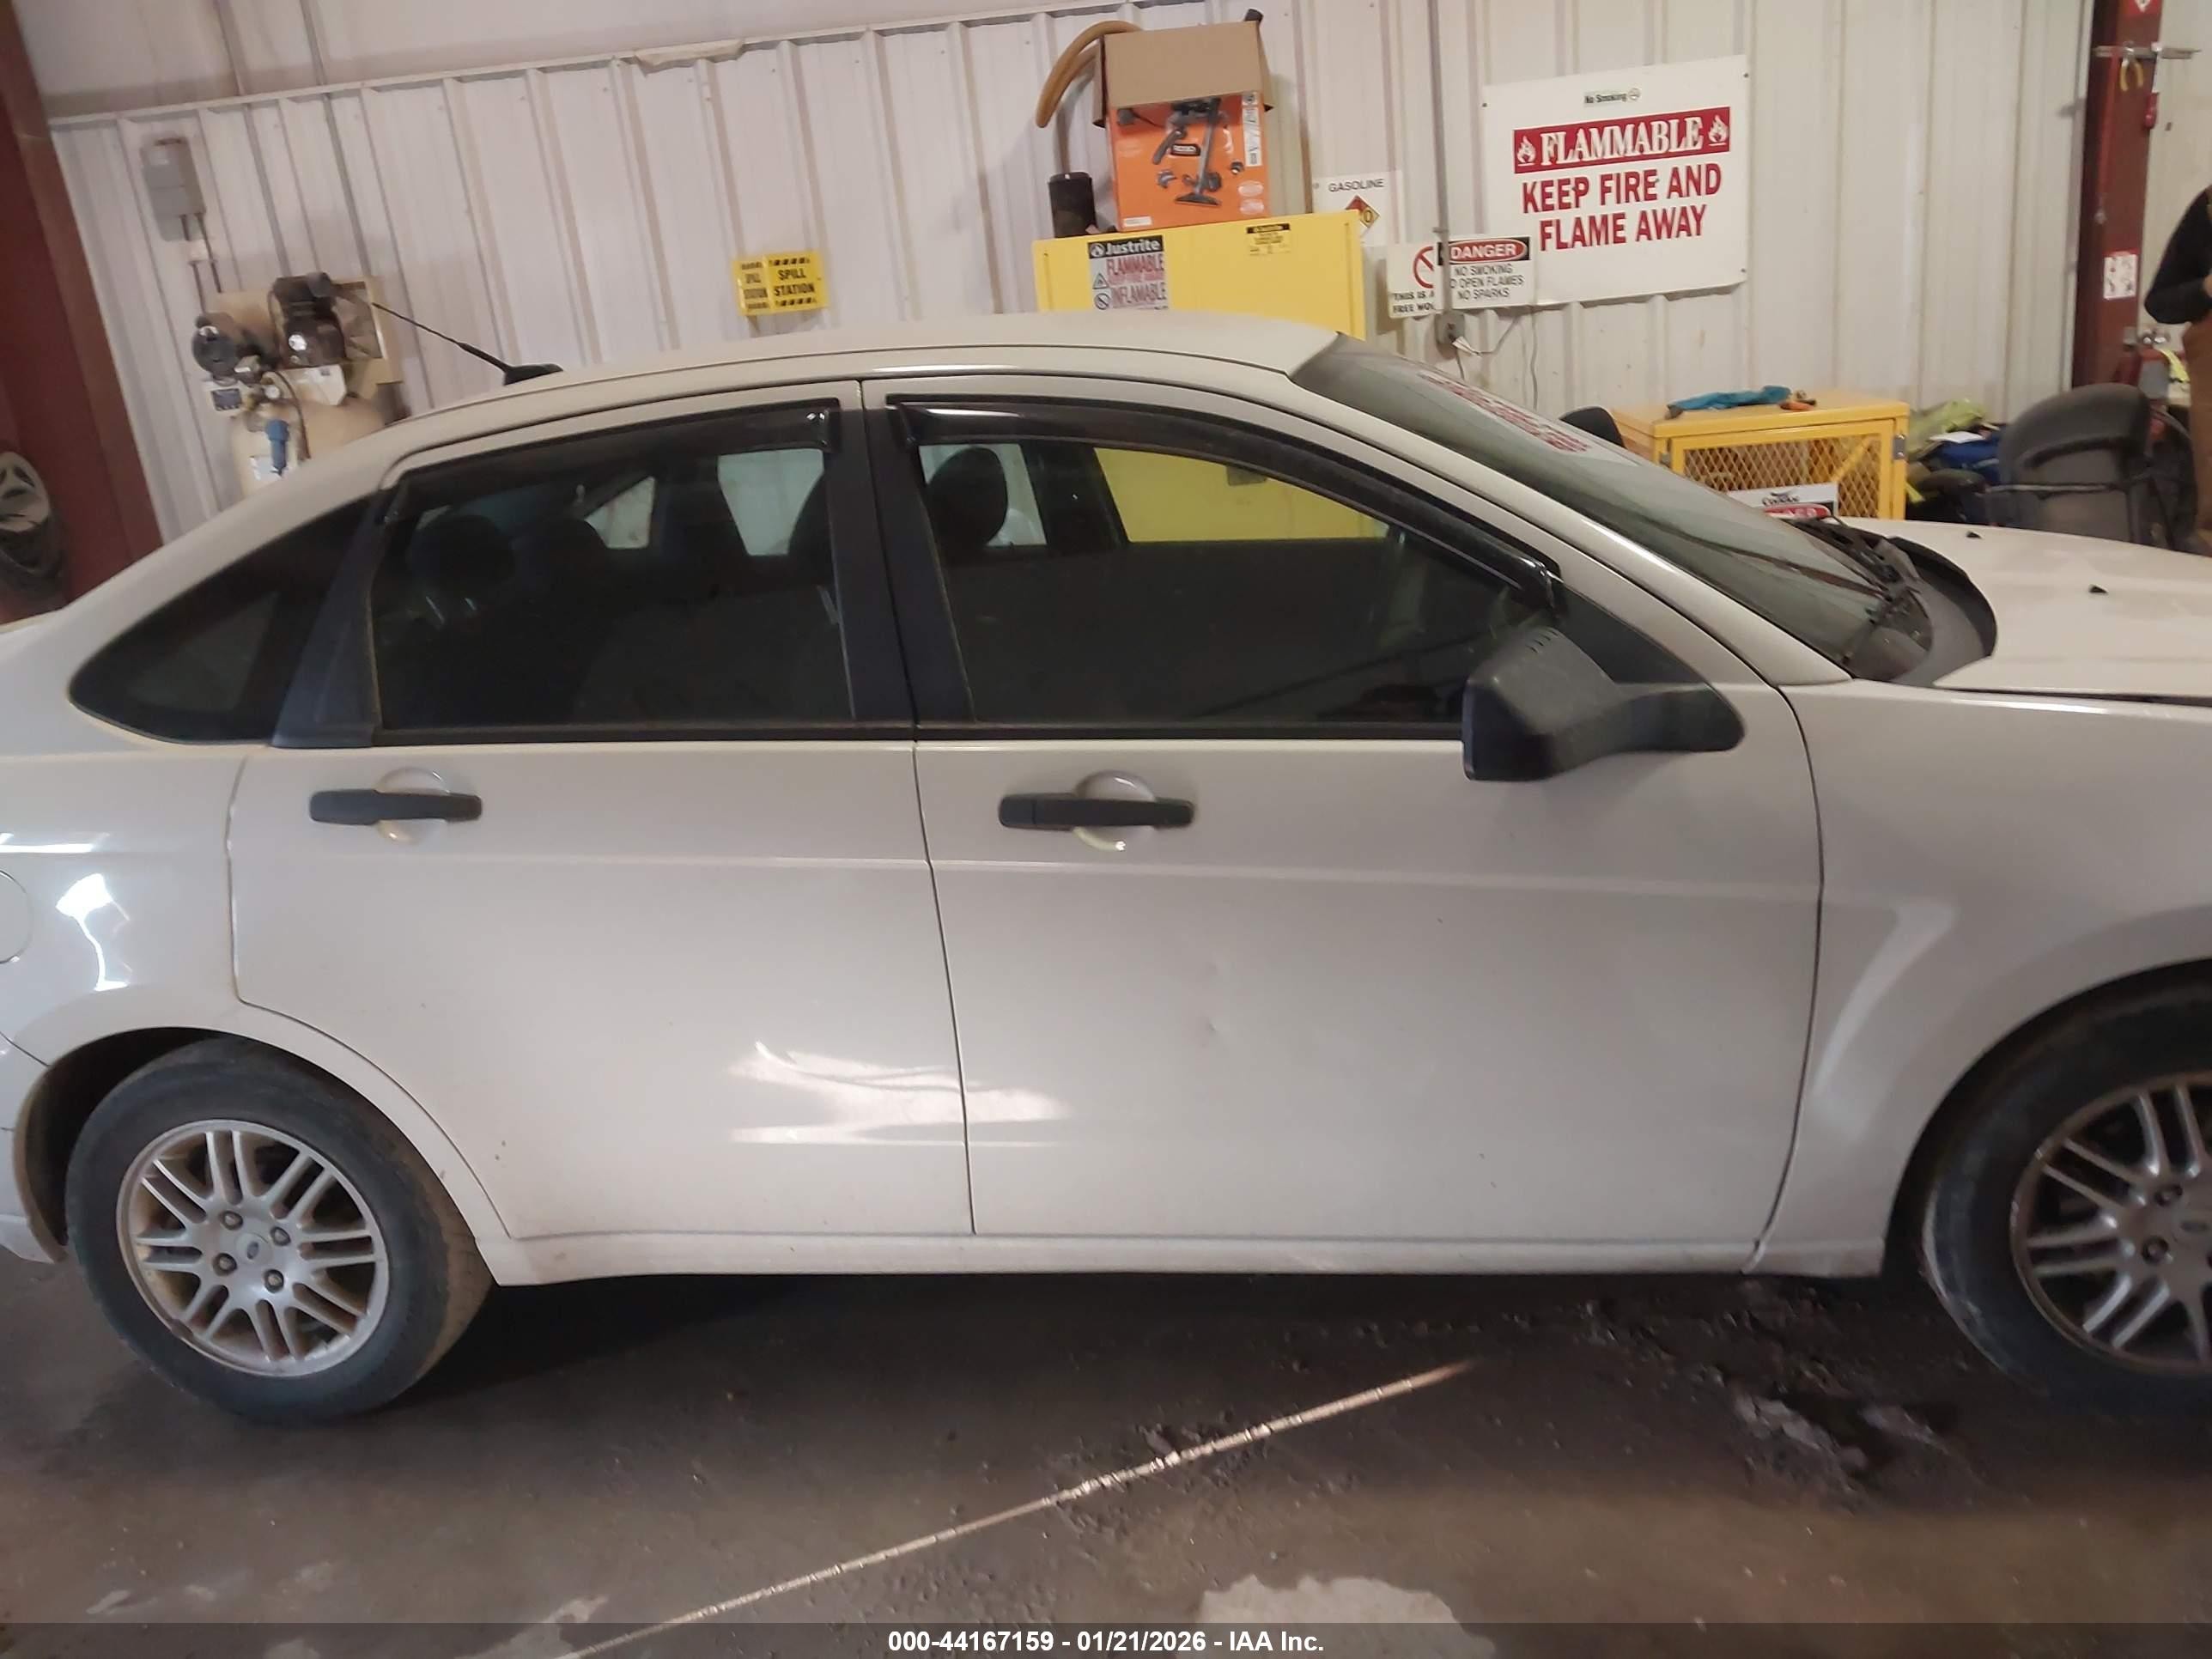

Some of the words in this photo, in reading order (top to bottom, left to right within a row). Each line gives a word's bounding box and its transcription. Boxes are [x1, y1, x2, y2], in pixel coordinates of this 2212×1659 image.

[1540, 117, 1704, 166] FLAMMABLE
[1328, 178, 1384, 192] GASOLINE
[1522, 176, 1589, 213] KEEP
[1600, 169, 1658, 205] FIRE
[1667, 163, 1722, 199] AND
[1539, 212, 1626, 252] FLAME
[1636, 204, 1707, 242] AWAY
[1106, 239, 1161, 256] Justrite
[1450, 243, 1516, 259] DANGER
[1106, 253, 1164, 276] FLAMMABLE
[1455, 266, 1468, 276] NO
[1470, 263, 1512, 276] SMOKING
[778, 268, 806, 281] SPILL
[1459, 276, 1484, 289] OPEN
[1486, 274, 1524, 287] FLAMES
[774, 283, 815, 297] STATION
[1458, 289, 1471, 301] NO
[1473, 287, 1510, 300] SPARKS
